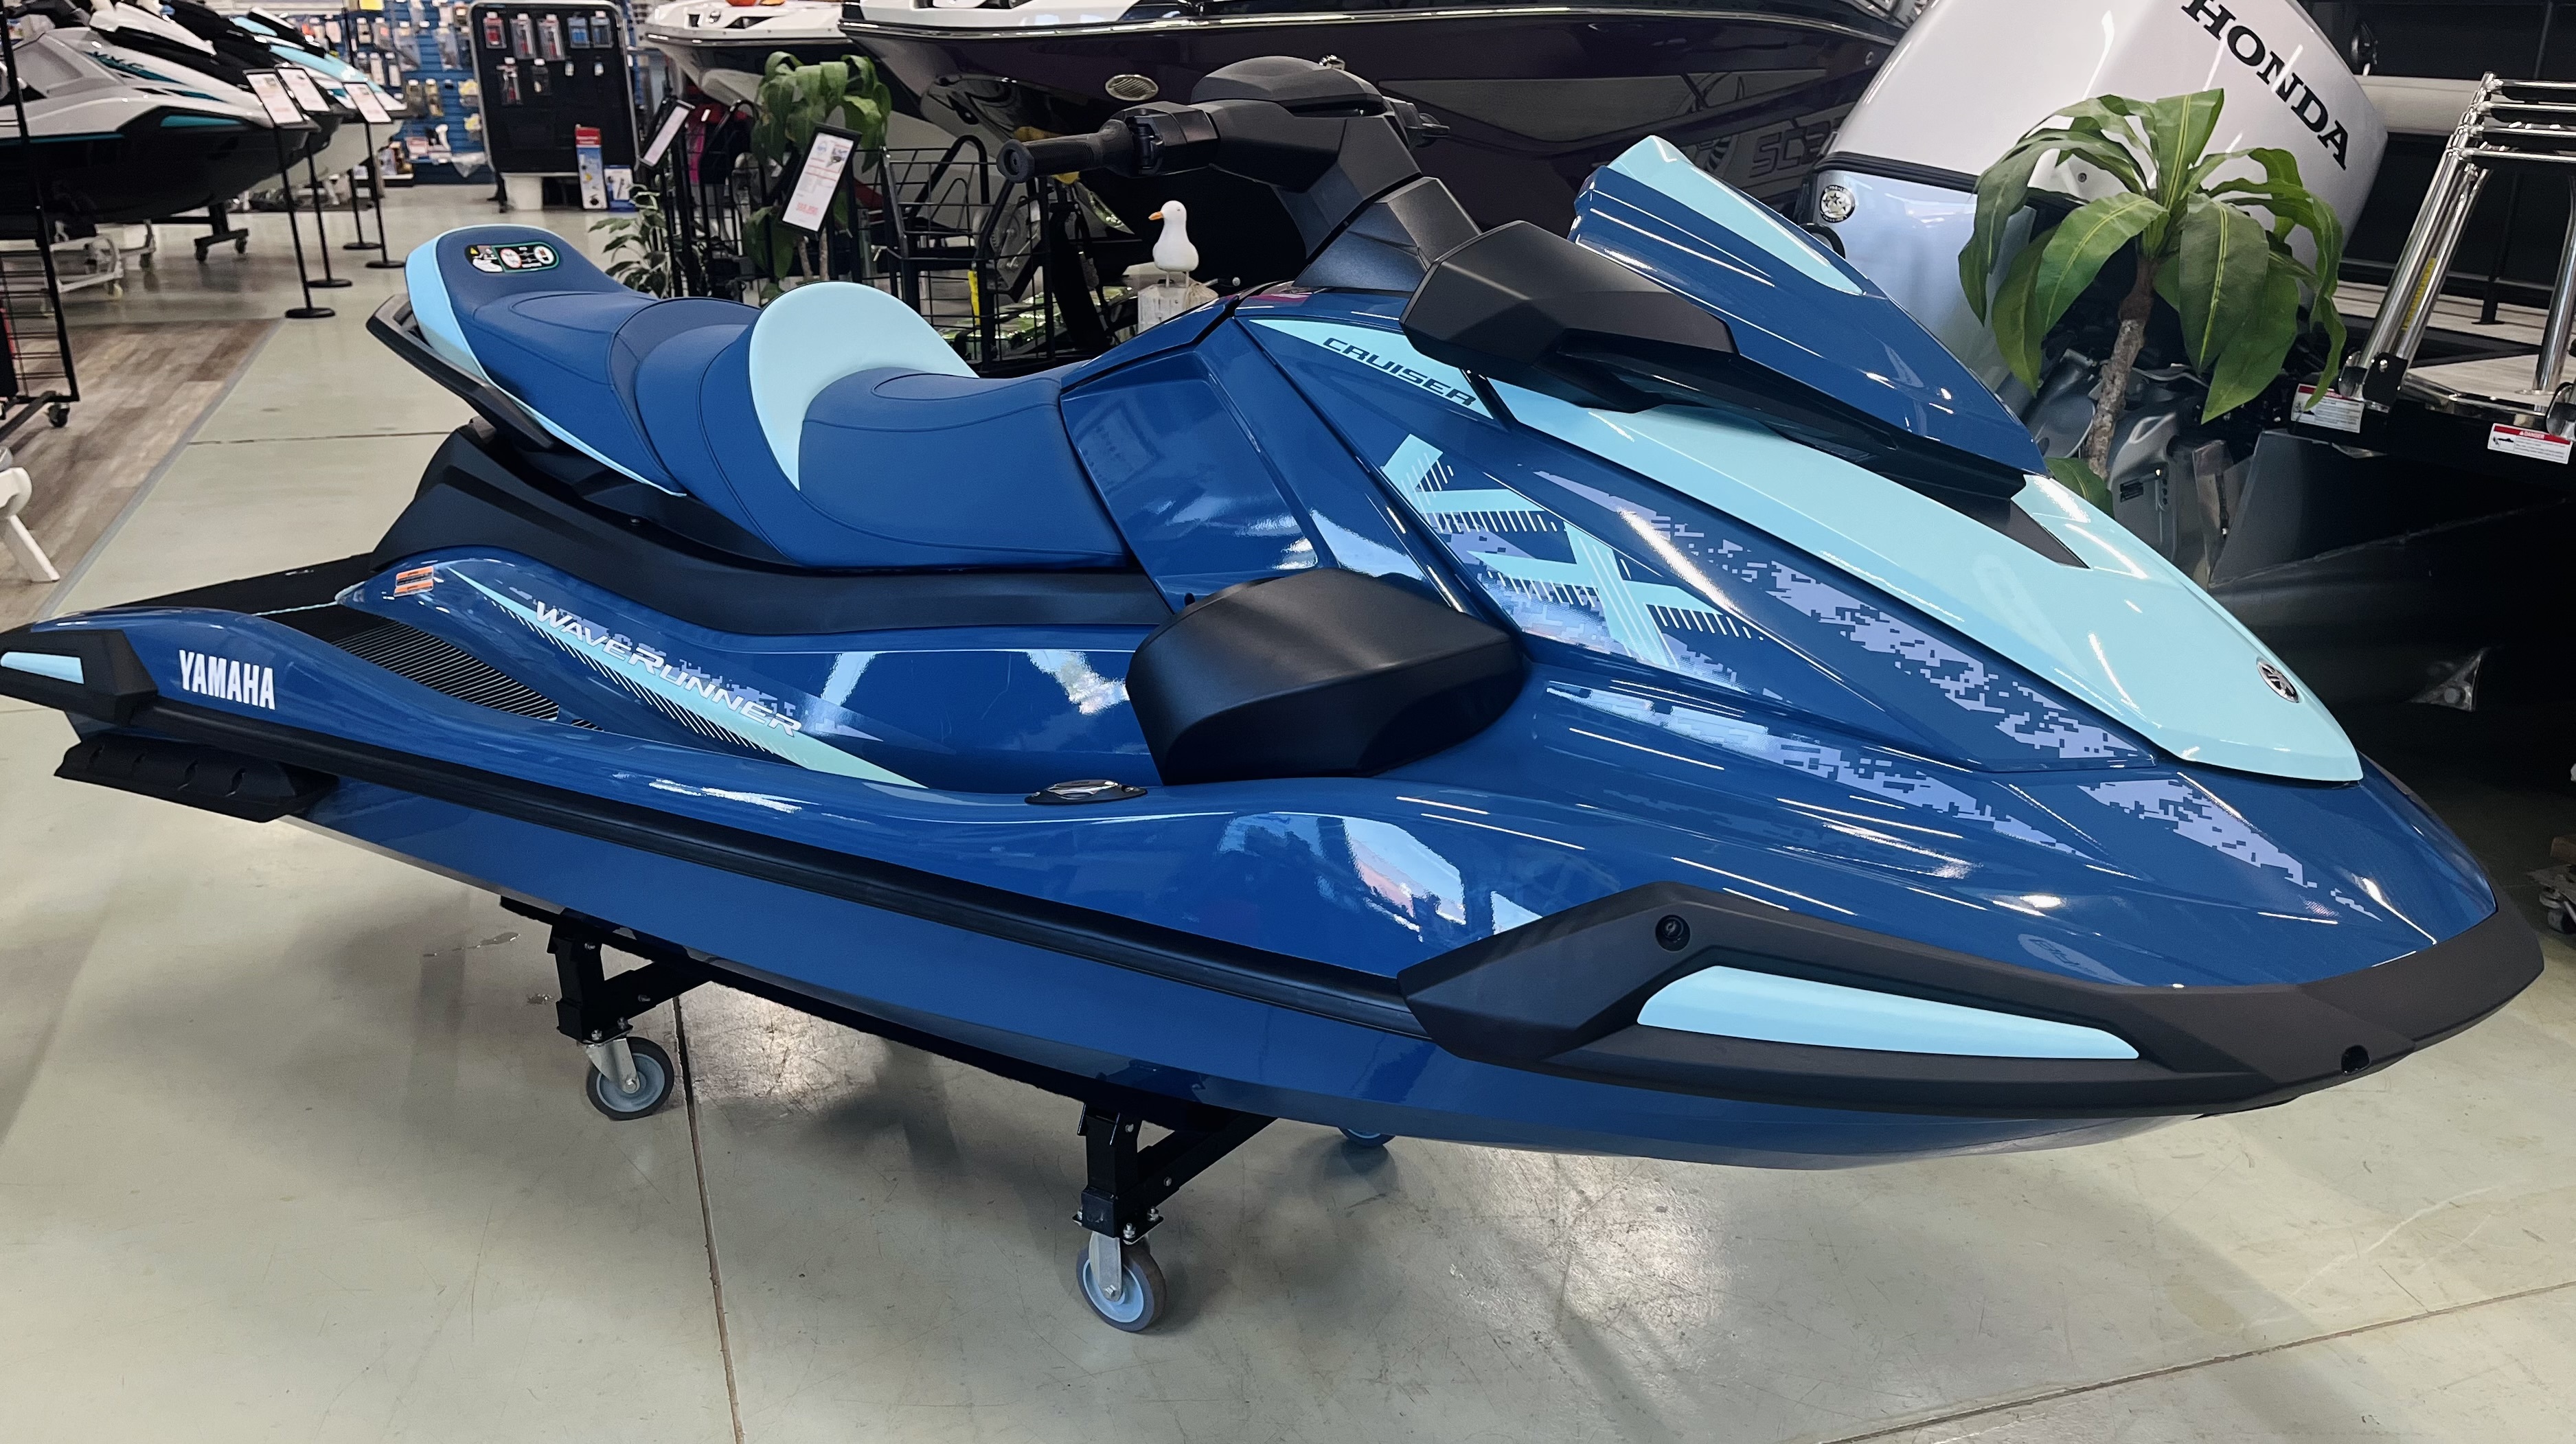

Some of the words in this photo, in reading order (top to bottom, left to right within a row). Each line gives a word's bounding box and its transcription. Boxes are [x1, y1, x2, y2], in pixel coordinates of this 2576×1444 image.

[2181, 0, 2348, 170] HONDA
[1323, 337, 1476, 406] CRUISER
[179, 650, 275, 710] YAMAHA
